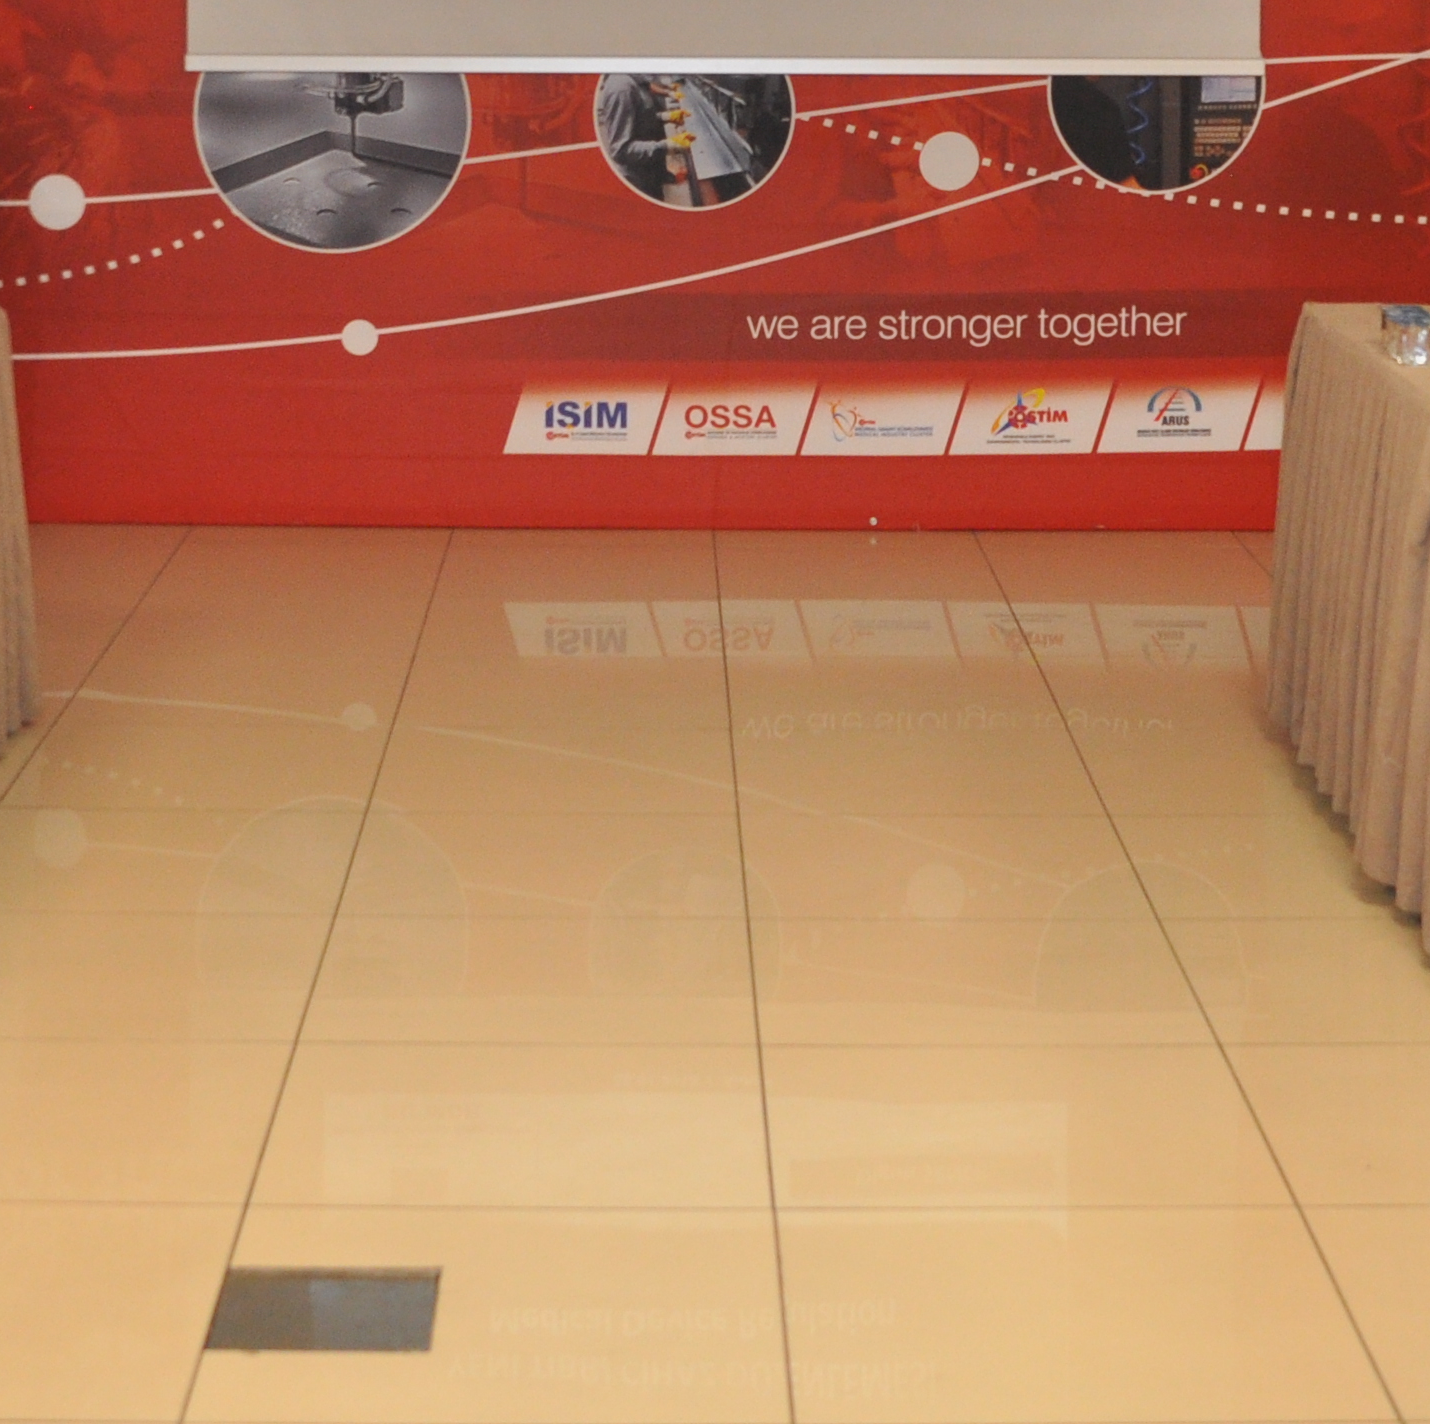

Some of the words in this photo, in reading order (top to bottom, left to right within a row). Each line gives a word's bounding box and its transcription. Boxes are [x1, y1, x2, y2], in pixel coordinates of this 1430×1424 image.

[746, 314, 800, 339] we
[809, 315, 867, 340] are
[877, 310, 1028, 347] stronger
[1038, 305, 1188, 346] together
[684, 404, 777, 429] OSSA
[1161, 415, 1190, 426] ARUS
